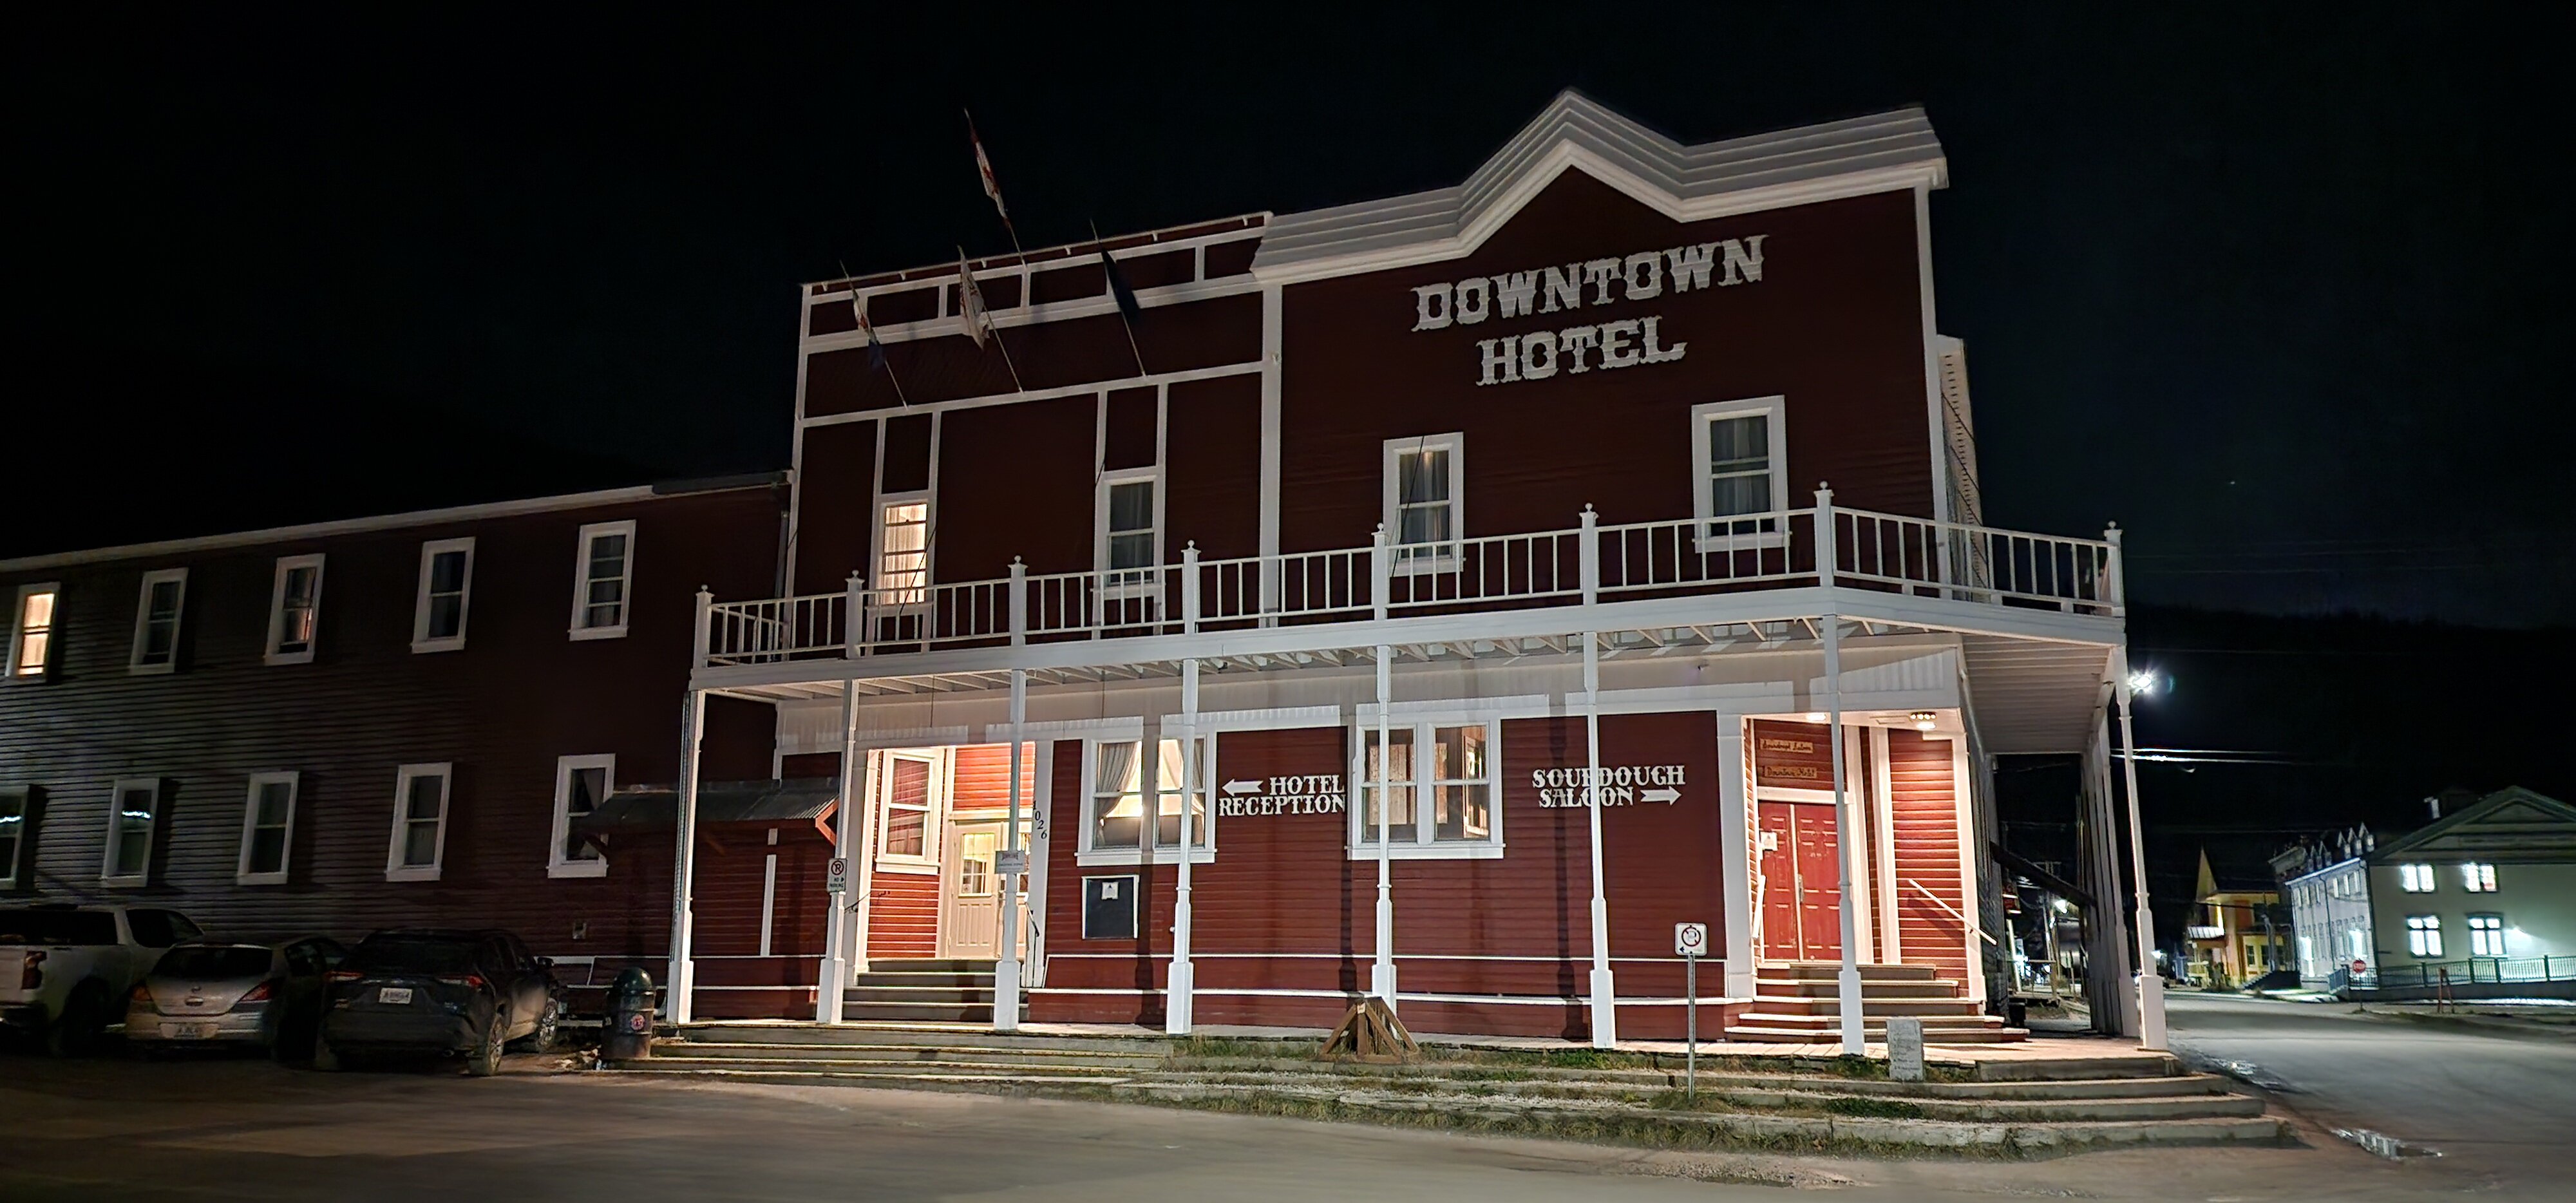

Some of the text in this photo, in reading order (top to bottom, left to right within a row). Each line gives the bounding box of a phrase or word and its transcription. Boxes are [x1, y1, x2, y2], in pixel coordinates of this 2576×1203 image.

[1411, 234, 1768, 332] DOWNTOWN
[1476, 315, 1688, 386] HOTEL
[1269, 775, 1345, 796] HOTEL
[1033, 800, 1047, 839] 1026
[1219, 794, 1346, 817] RECEPTION
